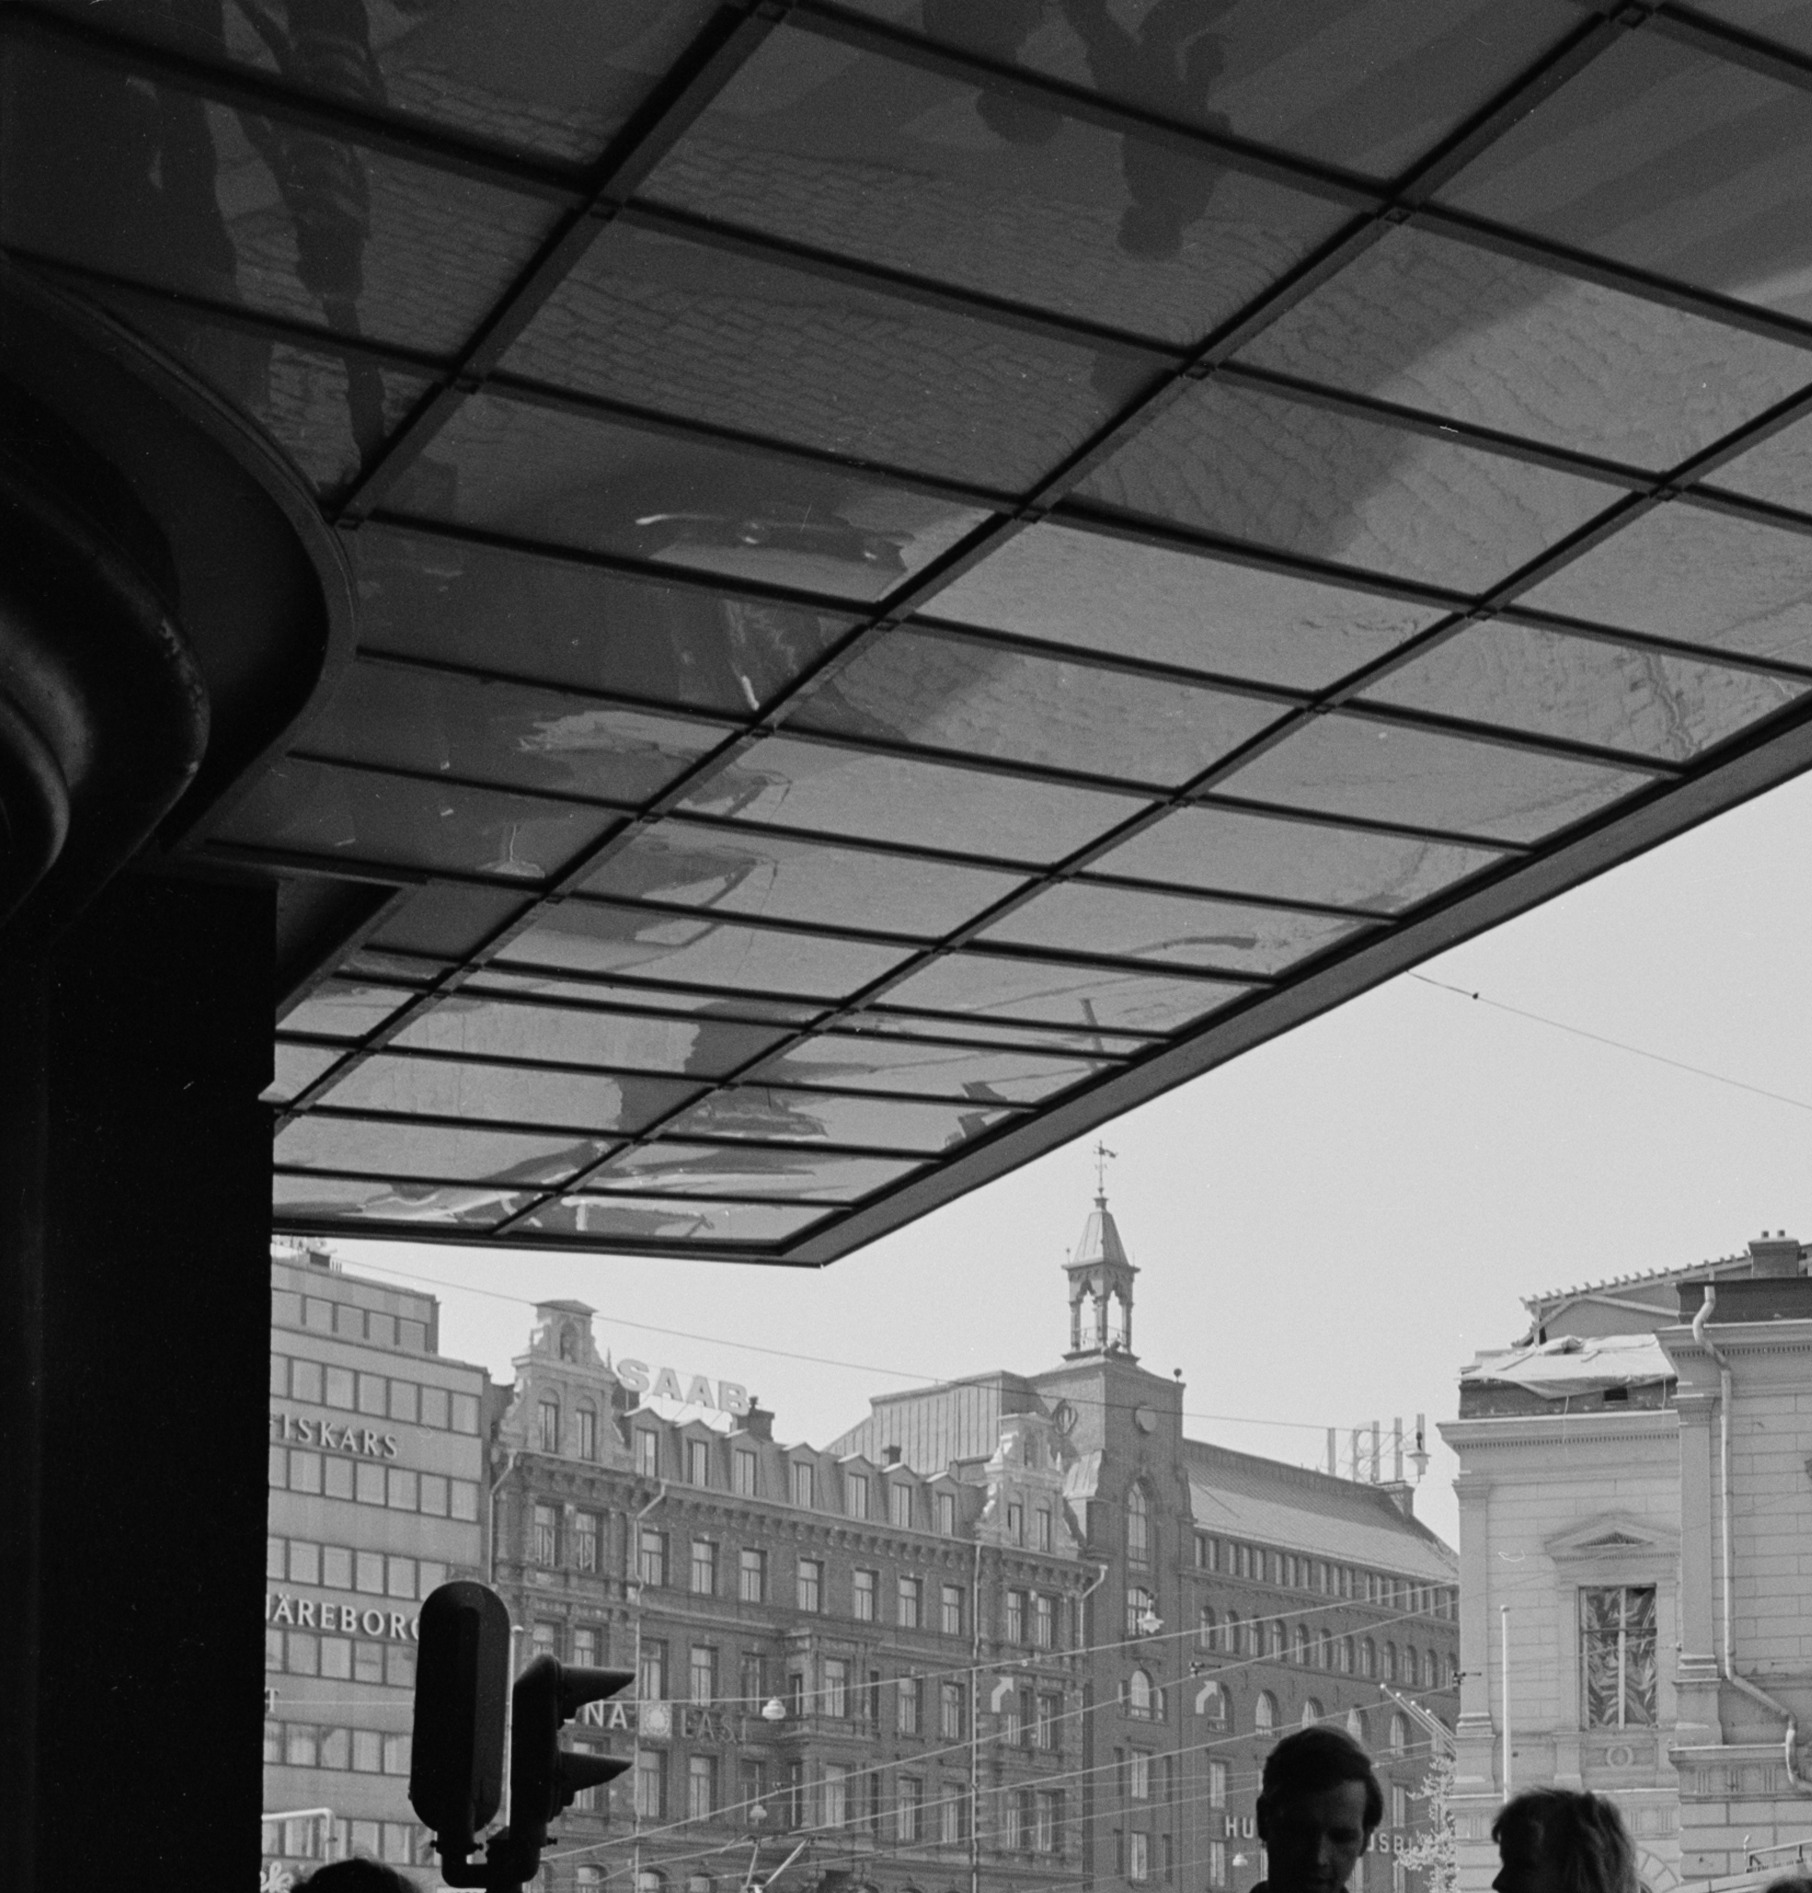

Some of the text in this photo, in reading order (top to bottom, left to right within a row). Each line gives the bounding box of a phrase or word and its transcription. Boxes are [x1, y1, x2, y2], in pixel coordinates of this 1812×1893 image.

[615, 1357, 751, 1416] SAAB
[269, 1413, 398, 1459] ISKARS
[266, 1592, 420, 1641] JÄREBOR
